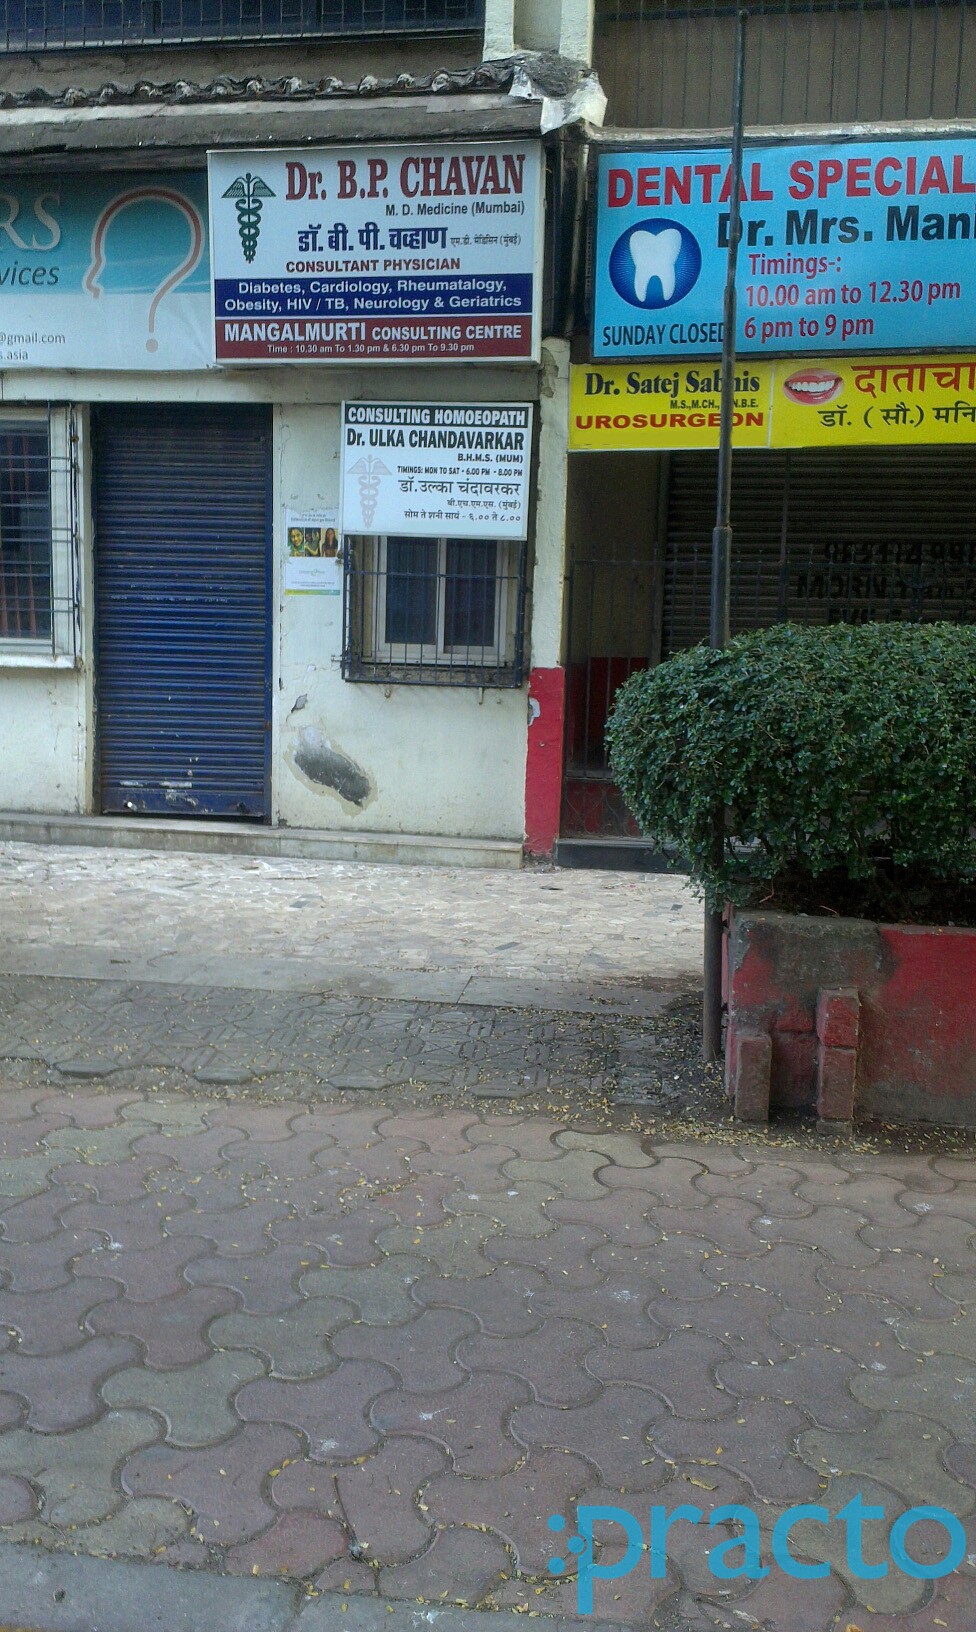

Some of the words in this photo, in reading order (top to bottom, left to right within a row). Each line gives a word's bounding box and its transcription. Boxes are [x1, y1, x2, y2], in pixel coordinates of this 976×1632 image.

[284, 161, 327, 201] Dr.
[337, 158, 389, 199] B.P.
[399, 154, 526, 198] CHAVAN
[607, 163, 774, 208] DENTAL
[788, 155, 976, 201] SPECIAL
[385, 203, 400, 216] M.
[402, 203, 415, 216] D.
[416, 202, 469, 216] Medicine
[470, 200, 526, 217] (Mumbai)
[297, 223, 324, 252] डॉ.
[388, 226, 449, 250] चव्हाण
[717, 212, 774, 248] Dr.
[785, 208, 873, 246] Mrs.
[886, 205, 976, 242] Man
[285, 259, 379, 274] CONSULTANT
[383, 257, 461, 271] PHYSICIAN
[749, 252, 842, 279] Timings-:
[238, 280, 306, 295] Diabetes,
[309, 279, 393, 296] Cardiology,
[397, 278, 508, 295] Rheumatalogy,
[746, 283, 799, 308] 10.00
[804, 286, 837, 305] am
[841, 282, 862, 305] to
[869, 280, 924, 304] 12.30
[927, 282, 961, 309] pm
[224, 297, 283, 313] Obesity,
[286, 297, 312, 311] HIV
[324, 296, 349, 313] TB,
[353, 295, 430, 312] Neurology
[434, 295, 445, 309] &
[448, 294, 522, 308] Geriatrics
[224, 321, 366, 343] MANGALMURTI
[371, 325, 462, 341] CONSULTING
[465, 324, 522, 340] CENTRE
[602, 323, 665, 347] SUNDAY
[668, 321, 727, 345] CLOSED
[744, 317, 757, 339] 6
[761, 319, 794, 344] pm
[798, 315, 819, 337] to
[824, 313, 837, 336] 9
[841, 315, 875, 341] pm
[266, 344, 288, 354] Time
[295, 344, 317, 354] 10.30
[320, 345, 333, 353] am
[335, 344, 345, 353] To
[347, 344, 364, 353] 1.30
[367, 345, 381, 355] pm
[383, 343, 390, 352] &
[391, 343, 409, 352] 6.30
[411, 345, 426, 354] pm
[428, 343, 439, 352] To
[440, 342, 458, 352] 9.30
[461, 344, 475, 355] pm
[584, 372, 621, 395] Dr.
[626, 369, 680, 398] Satej
[347, 406, 431, 424] CONSULTING
[434, 409, 526, 426] HOMOEOPATH
[817, 404, 852, 428] डॉ.
[346, 428, 366, 446] Dr.
[369, 428, 405, 448] ULKA
[408, 429, 525, 450] CHANDAVARKAR
[457, 453, 493, 463] B.H.M.S.
[495, 453, 524, 464] (MUM)
[397, 465, 423, 474] TIMINGS:
[424, 466, 438, 474] MON
[439, 466, 448, 475] TO
[448, 466, 460, 475] SAT
[465, 467, 480, 476] 6.00
[481, 468, 491, 477] PM
[513, 469, 523, 477] PM
[456, 478, 522, 497] चंदावरकर
